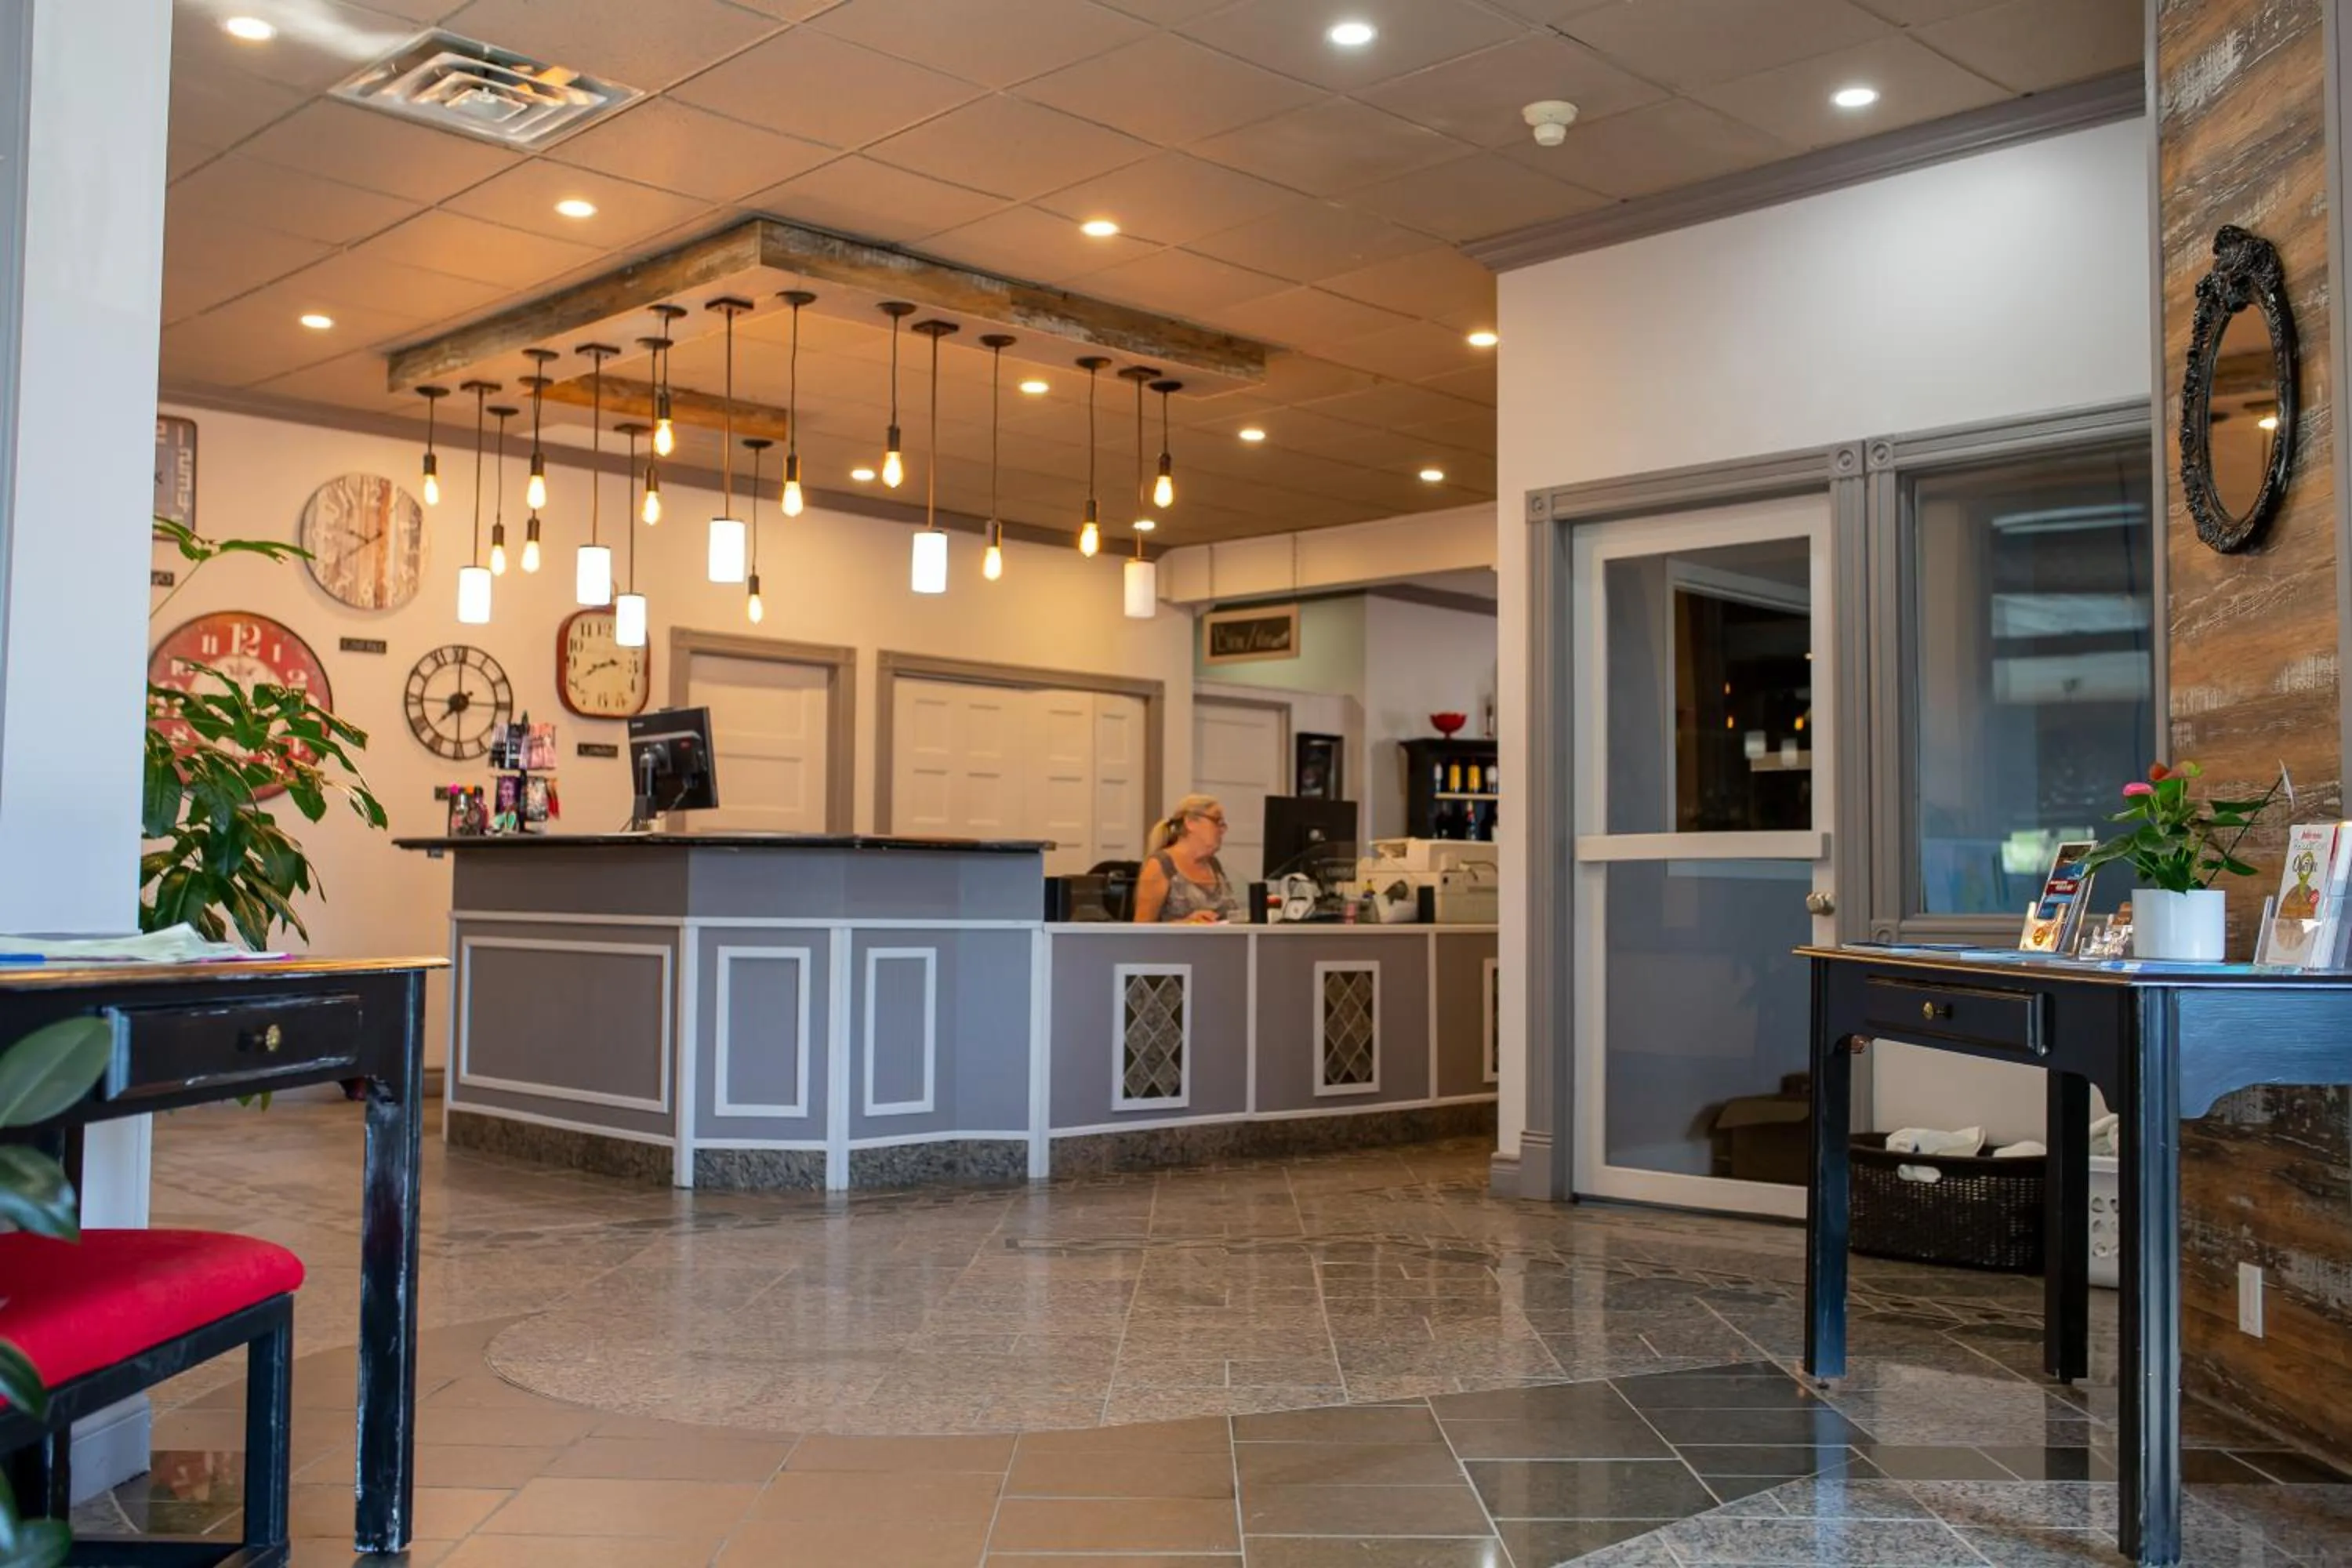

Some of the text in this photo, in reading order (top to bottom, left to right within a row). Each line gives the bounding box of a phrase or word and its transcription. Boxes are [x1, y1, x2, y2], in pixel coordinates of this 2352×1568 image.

[581, 622, 593, 638] 11
[597, 622, 613, 639] 12
[201, 634, 219, 655] 11
[232, 622, 261, 658] 12
[569, 637, 584, 654] 10
[273, 643, 281, 663] 1
